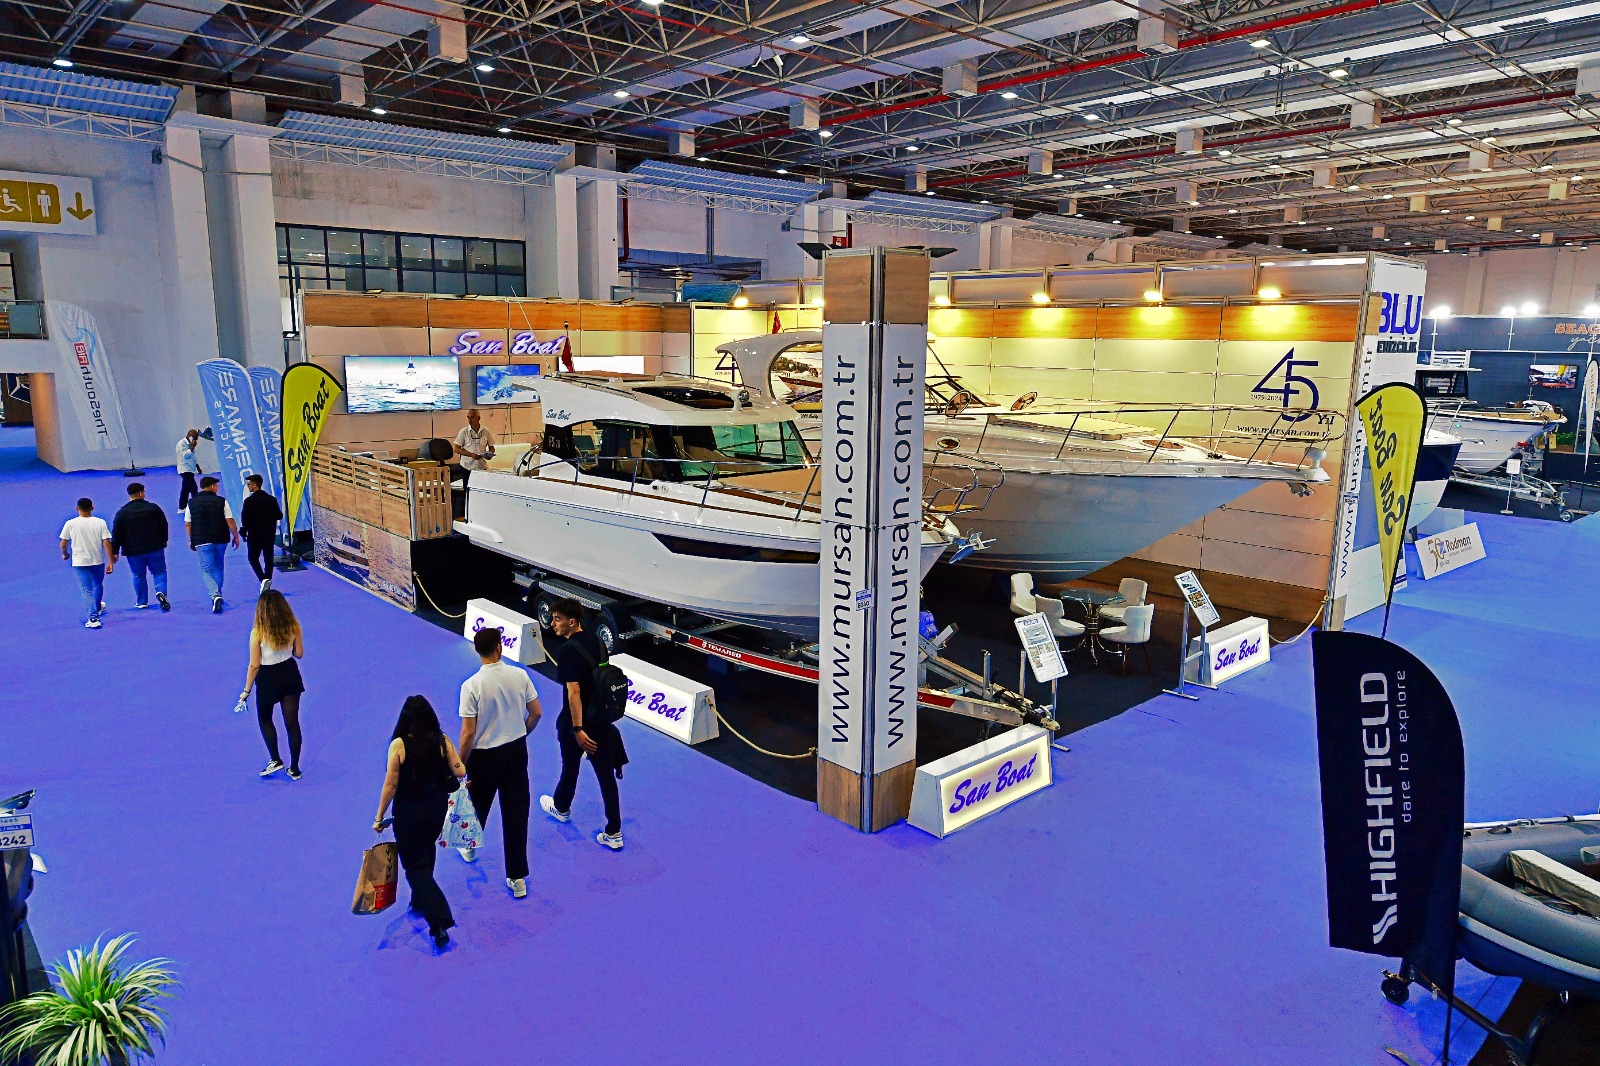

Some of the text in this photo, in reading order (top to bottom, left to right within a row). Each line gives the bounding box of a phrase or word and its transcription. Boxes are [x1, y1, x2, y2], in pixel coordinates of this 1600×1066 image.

[450, 330, 566, 355] San Boat
[1251, 347, 1319, 422] 45
[286, 377, 330, 483] San Boat
[832, 355, 856, 743] www.mursan.com.tr
[888, 355, 914, 749] www.mursan.com.tr
[1214, 637, 1261, 671] San Boat
[647, 692, 688, 722] Boat
[949, 752, 1038, 814] San Boat
[1396, 670, 1412, 823] dare to explore
[1359, 671, 1398, 902] HIGHFIELD
[0, 836, 27, 847] 242
